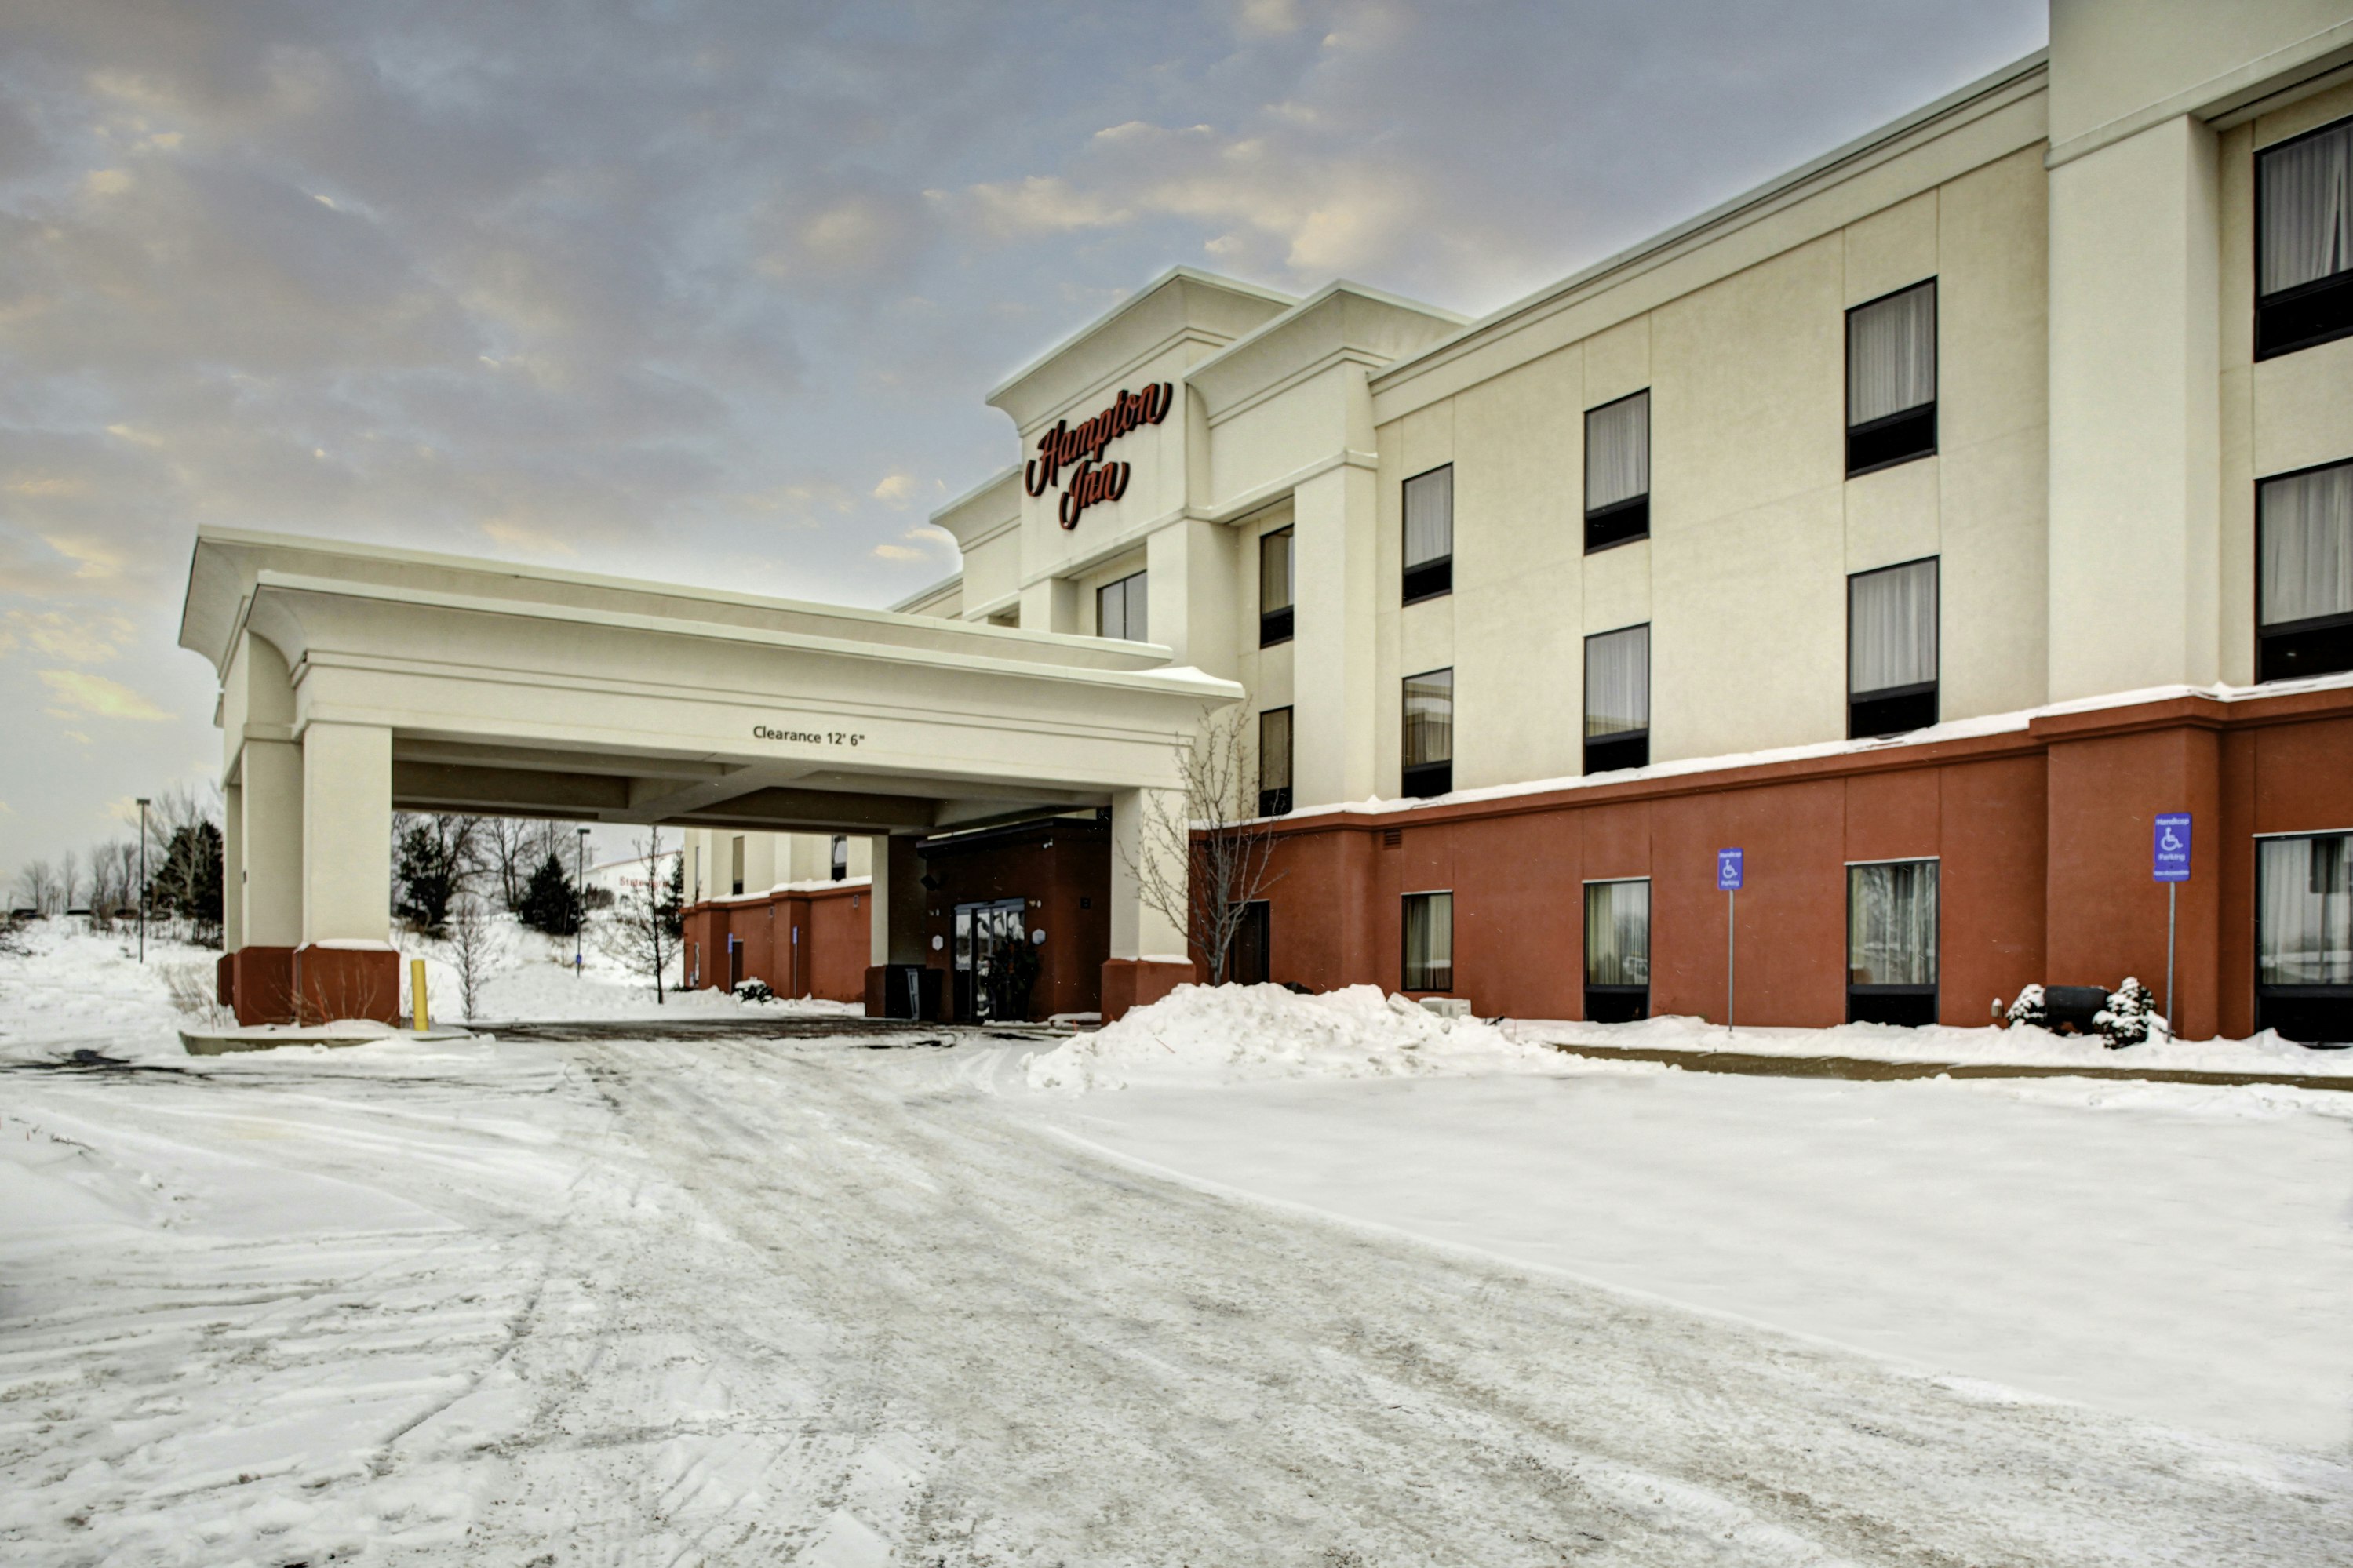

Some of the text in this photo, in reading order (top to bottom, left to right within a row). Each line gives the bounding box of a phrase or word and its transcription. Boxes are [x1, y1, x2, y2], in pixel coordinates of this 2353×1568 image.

[1025, 382, 1173, 497] Hampton
[1059, 460, 1130, 530] Inn
[753, 725, 821, 744] Clearance
[827, 732, 846, 745] 12'
[2158, 853, 2186, 862] Parking
